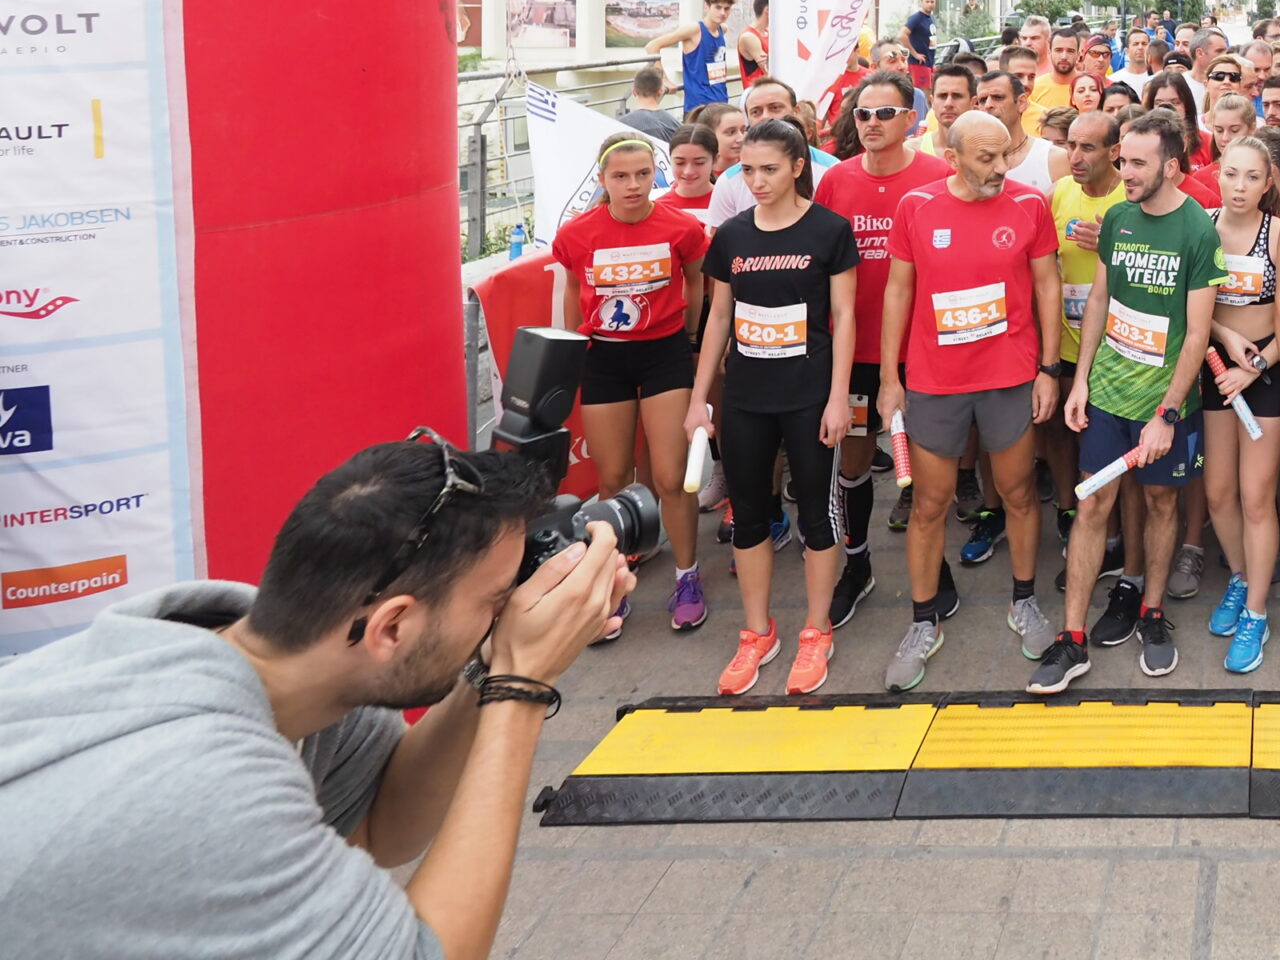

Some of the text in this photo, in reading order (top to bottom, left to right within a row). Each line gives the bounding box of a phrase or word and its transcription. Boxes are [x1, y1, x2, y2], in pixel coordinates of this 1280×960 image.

[13, 145, 35, 156] life
[15, 206, 132, 231] JAKOBSEN
[1114, 242, 1151, 254] ΣΥΛΛΟΓΟΣ
[600, 261, 664, 283] 432-1
[741, 254, 812, 273] RUNNING
[1125, 267, 1178, 287] ΥΓΕΙΑΣ
[1219, 273, 1256, 291] 8-1
[0, 287, 41, 308] ny
[1147, 285, 1176, 297] ΒΟΛΟΥ
[941, 302, 1000, 328] 436-1
[738, 322, 799, 343] 420-1
[1111, 319, 1156, 347] 203-1
[3, 494, 145, 528] INTERSPORT
[6, 568, 122, 602] Counterpain
